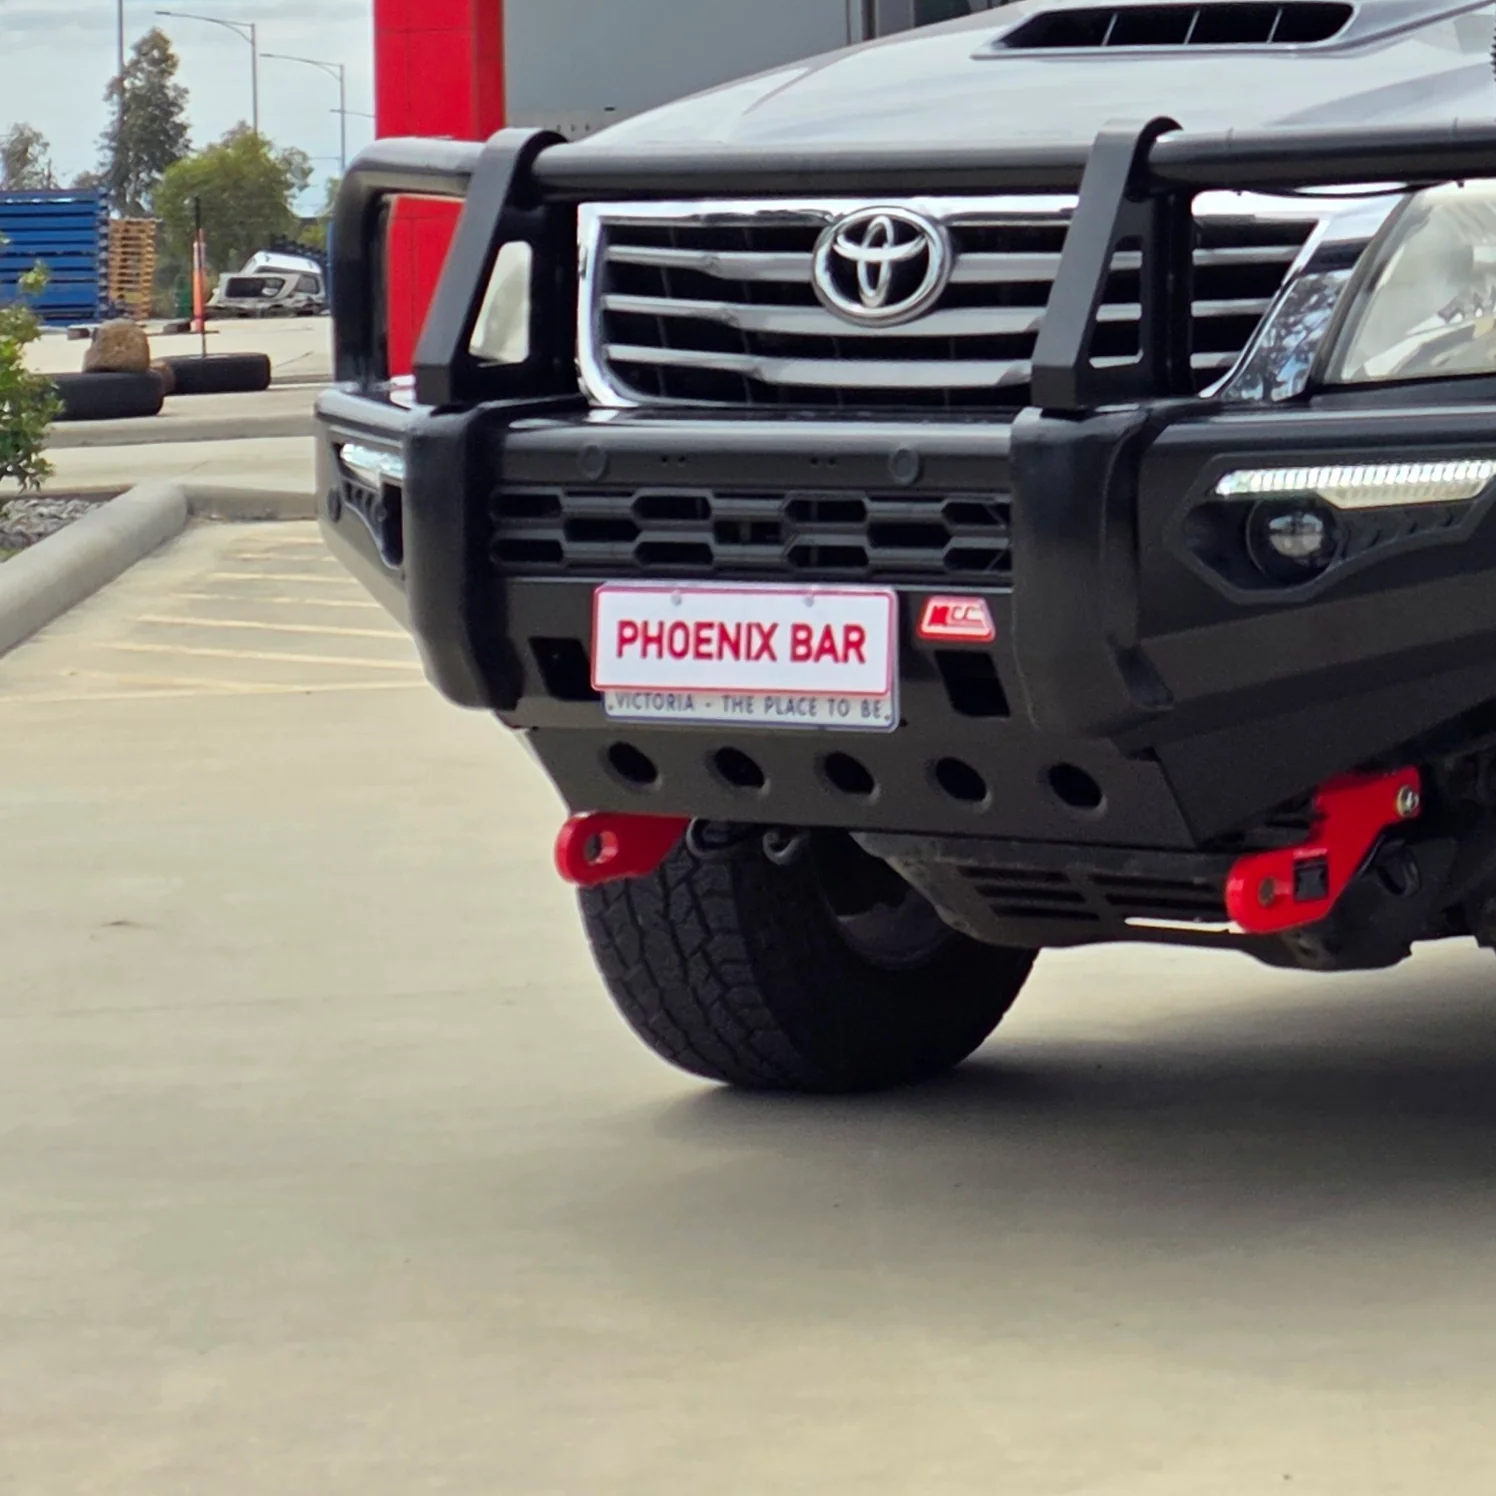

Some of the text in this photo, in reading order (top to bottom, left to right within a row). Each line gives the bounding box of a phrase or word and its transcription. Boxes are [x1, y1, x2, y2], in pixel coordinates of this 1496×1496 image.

[616, 620, 866, 664] PHOENIX BAR
[615, 691, 694, 712] VICTORIA
[720, 694, 755, 714] THE
[763, 696, 817, 718] PLACE
[828, 698, 851, 718] TO
[860, 699, 882, 719] BE
